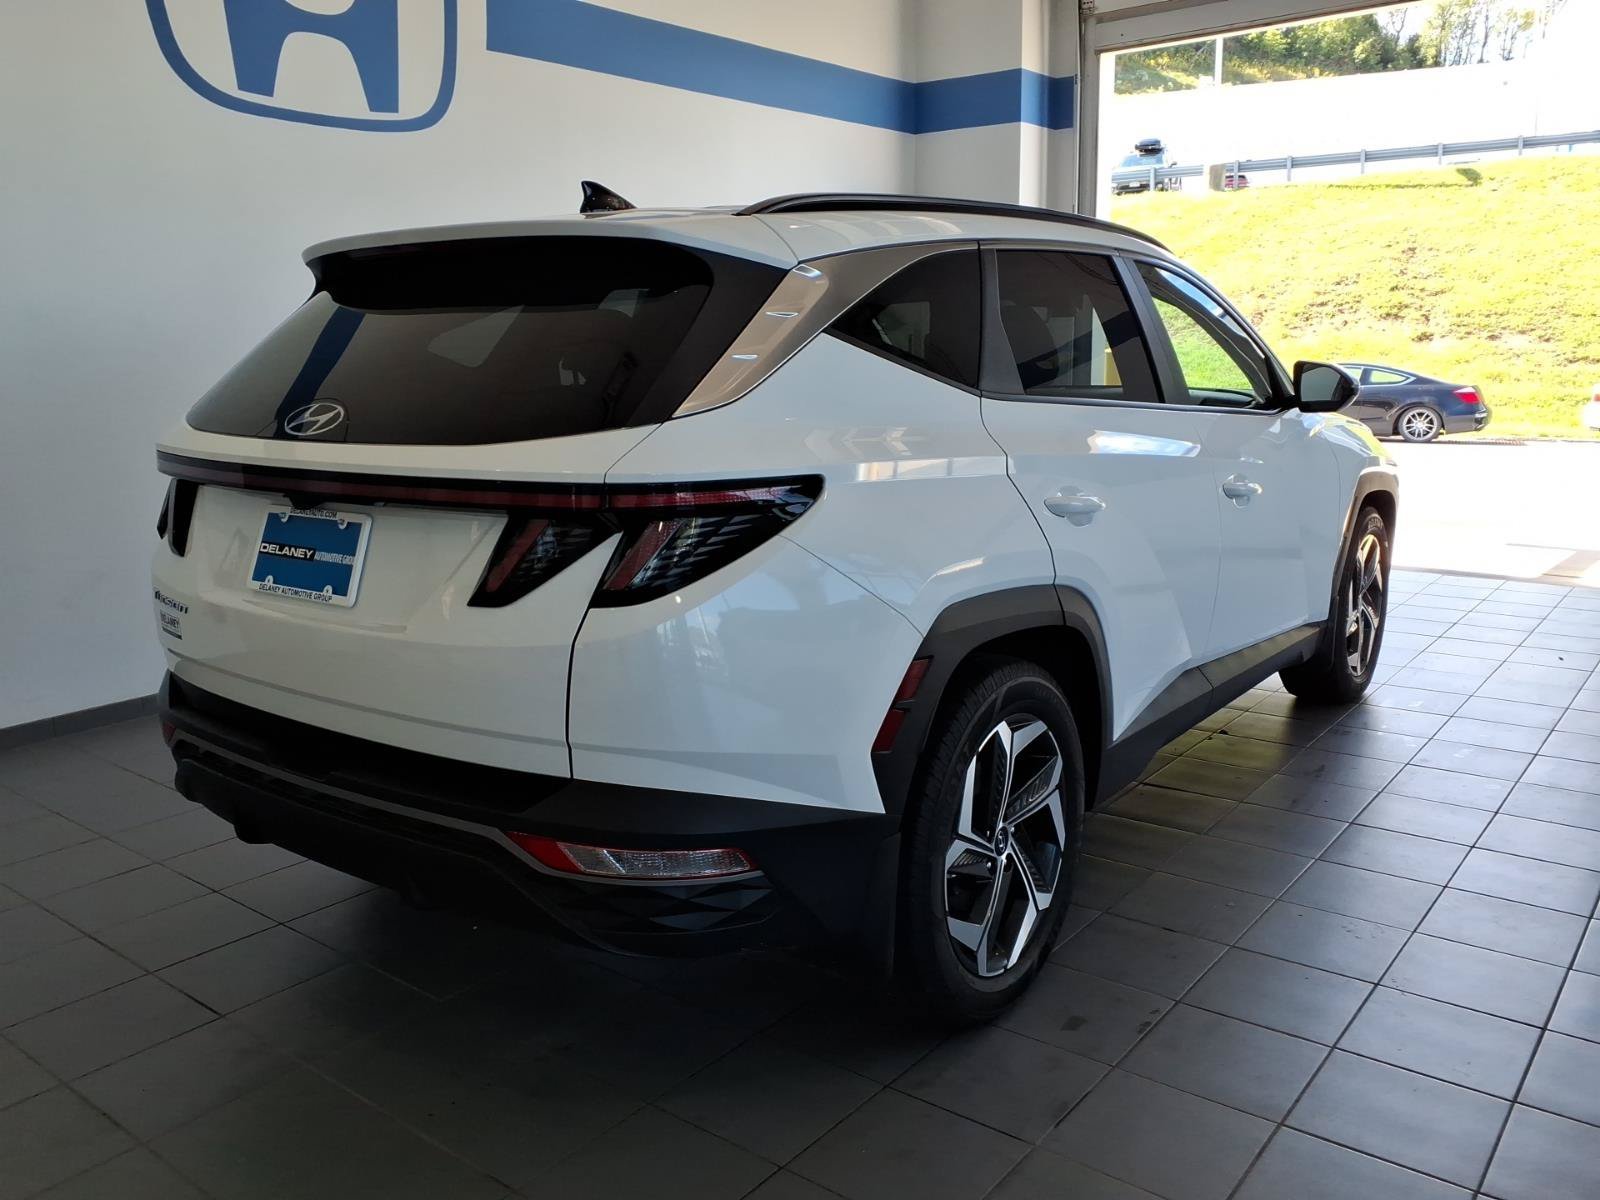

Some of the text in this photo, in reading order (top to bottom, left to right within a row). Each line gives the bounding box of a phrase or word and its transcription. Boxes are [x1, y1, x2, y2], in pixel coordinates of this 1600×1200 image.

[259, 542, 314, 560] DELANEY
[259, 583, 333, 603] DELANEY AUTOMOTIVE GROUP
